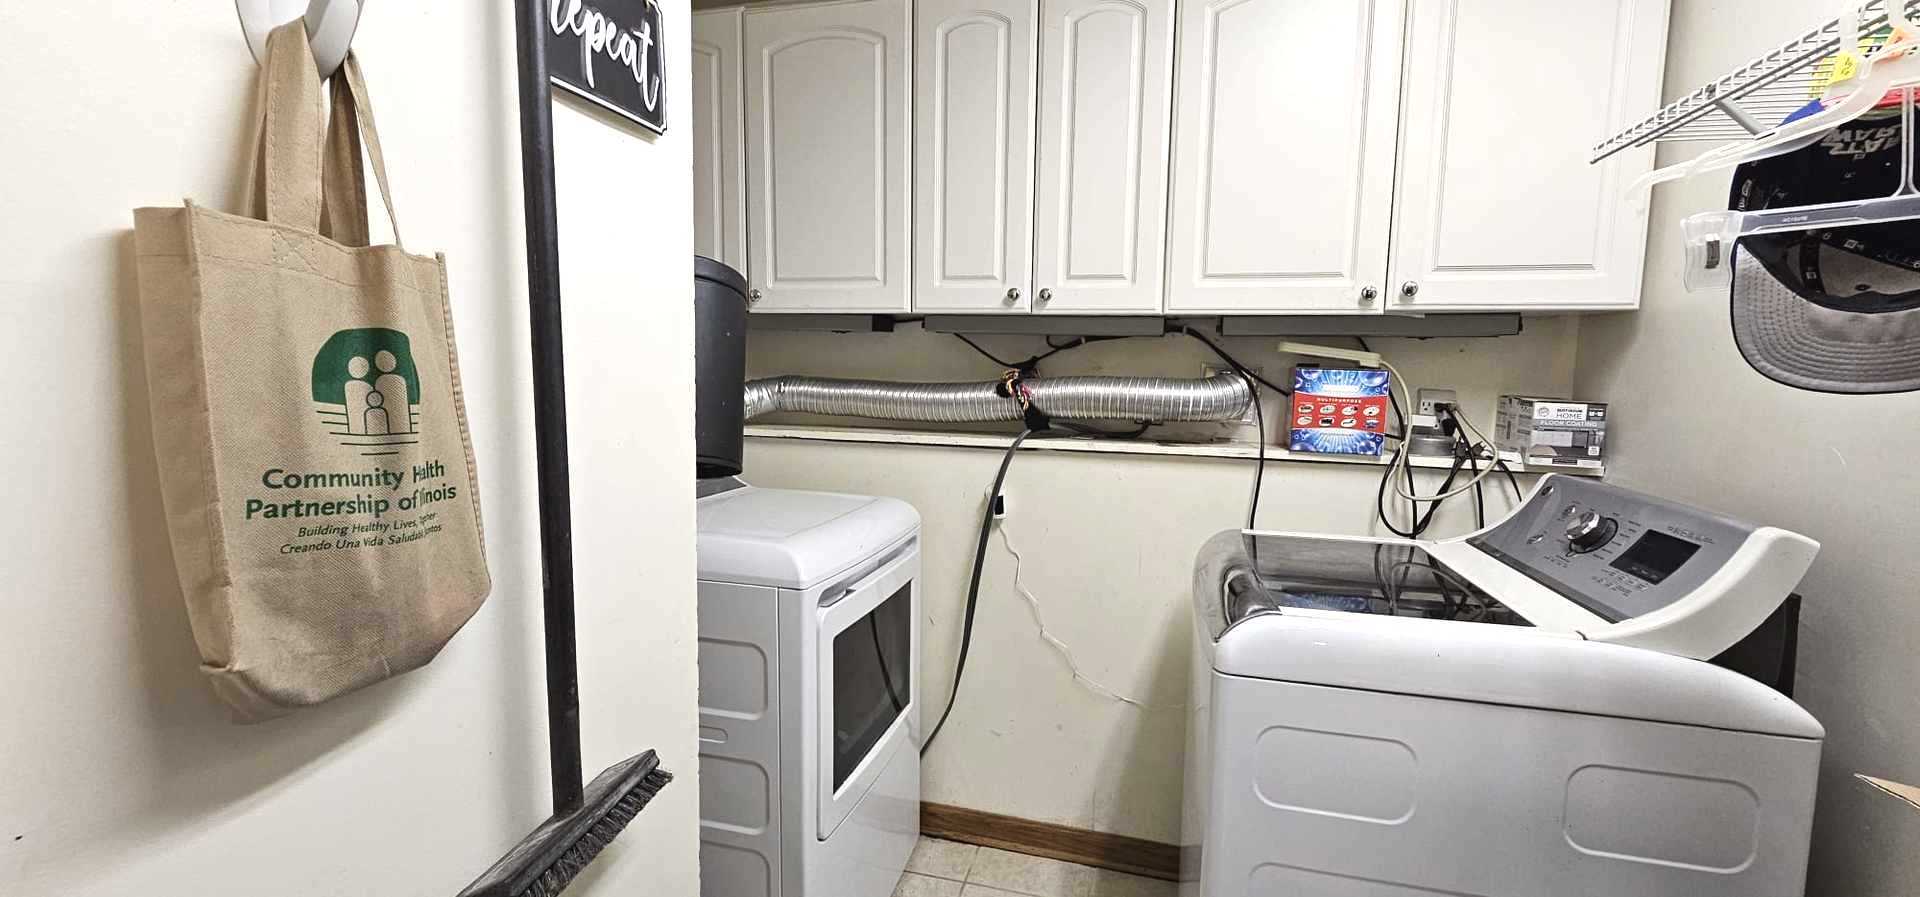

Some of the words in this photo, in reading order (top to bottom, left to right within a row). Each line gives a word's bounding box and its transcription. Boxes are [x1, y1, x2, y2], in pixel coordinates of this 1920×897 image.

[262, 467, 404, 491] Community
[246, 494, 390, 519] Partnership
[398, 489, 418, 510] of
[298, 524, 349, 537] Building
[352, 520, 390, 534] Healthy
[280, 540, 332, 554] Creando
[335, 539, 361, 550] Una
[363, 534, 384, 547] Vida
